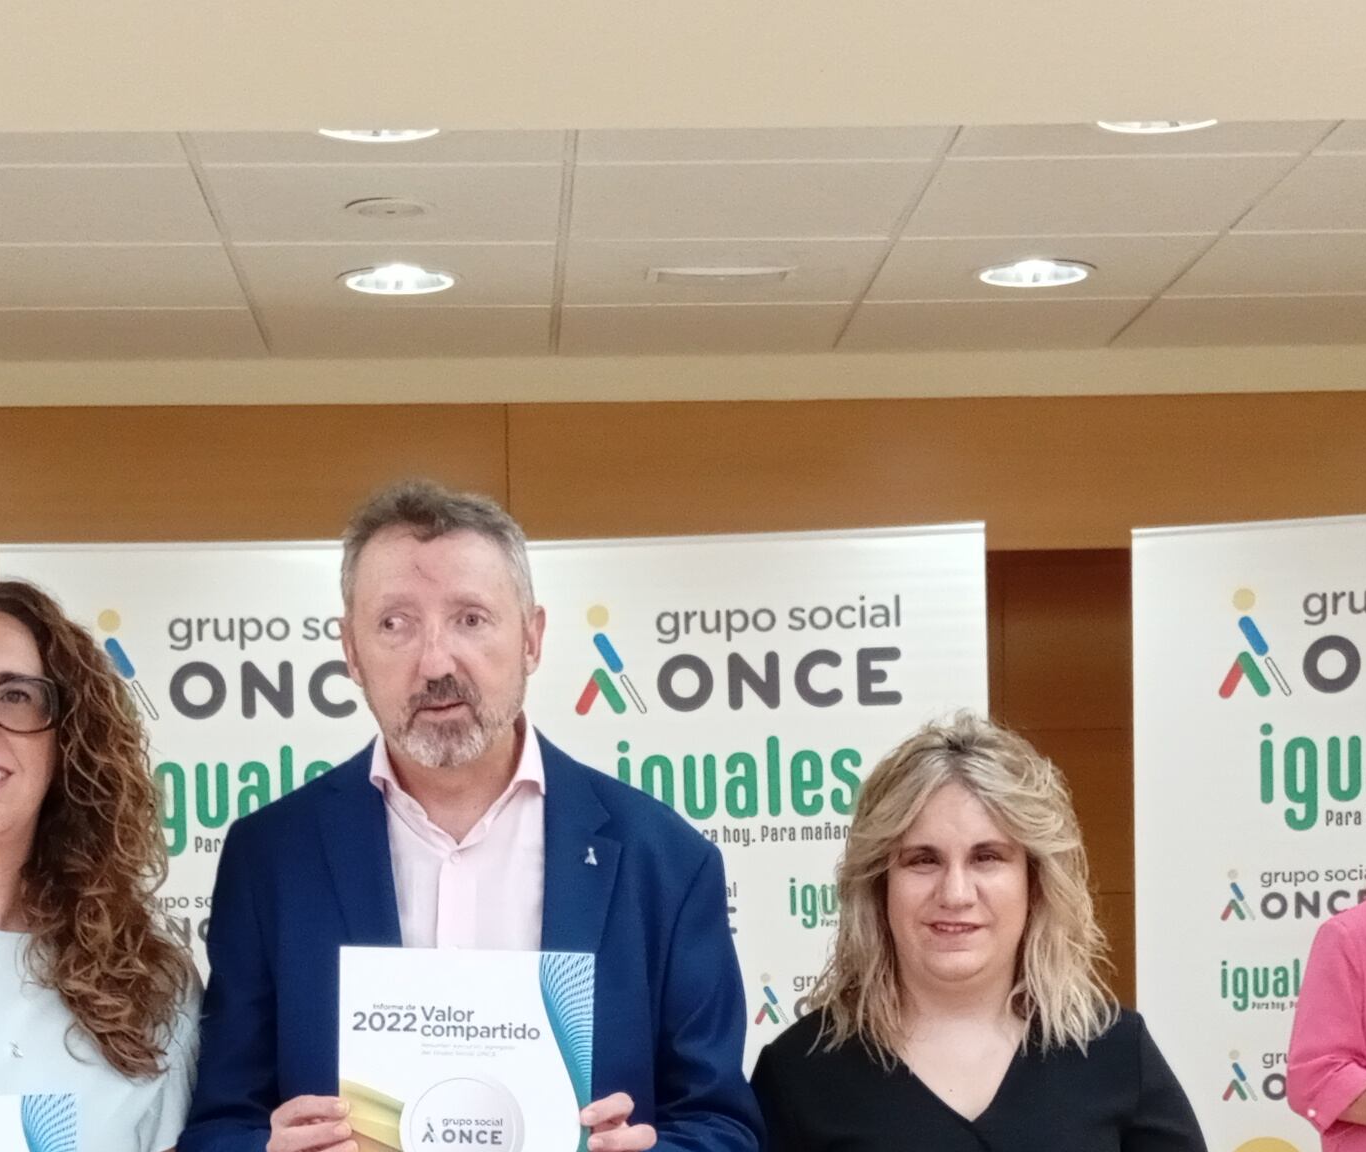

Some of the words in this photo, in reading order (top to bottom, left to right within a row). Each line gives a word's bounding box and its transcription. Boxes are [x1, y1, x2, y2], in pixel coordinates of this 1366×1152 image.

[655, 603, 776, 643] grupo
[787, 595, 902, 631] social
[168, 617, 290, 651] grupo
[169, 660, 357, 720] ONC
[656, 646, 903, 712] ONCE
[1326, 809, 1361, 826] Para
[195, 836, 223, 853] Par
[702, 828, 717, 842] ra
[723, 825, 756, 846] hoy.
[761, 825, 796, 842] Para
[801, 822, 851, 840] mañan
[1260, 869, 1319, 887] grupo
[1220, 958, 1301, 1012] igual
[352, 1011, 417, 1032] 2022
[421, 1006, 475, 1022] Valor
[421, 1023, 540, 1041] compartido
[442, 1118, 471, 1128] grupo
[473, 1117, 503, 1127] social
[442, 1129, 503, 1145] ONCE
